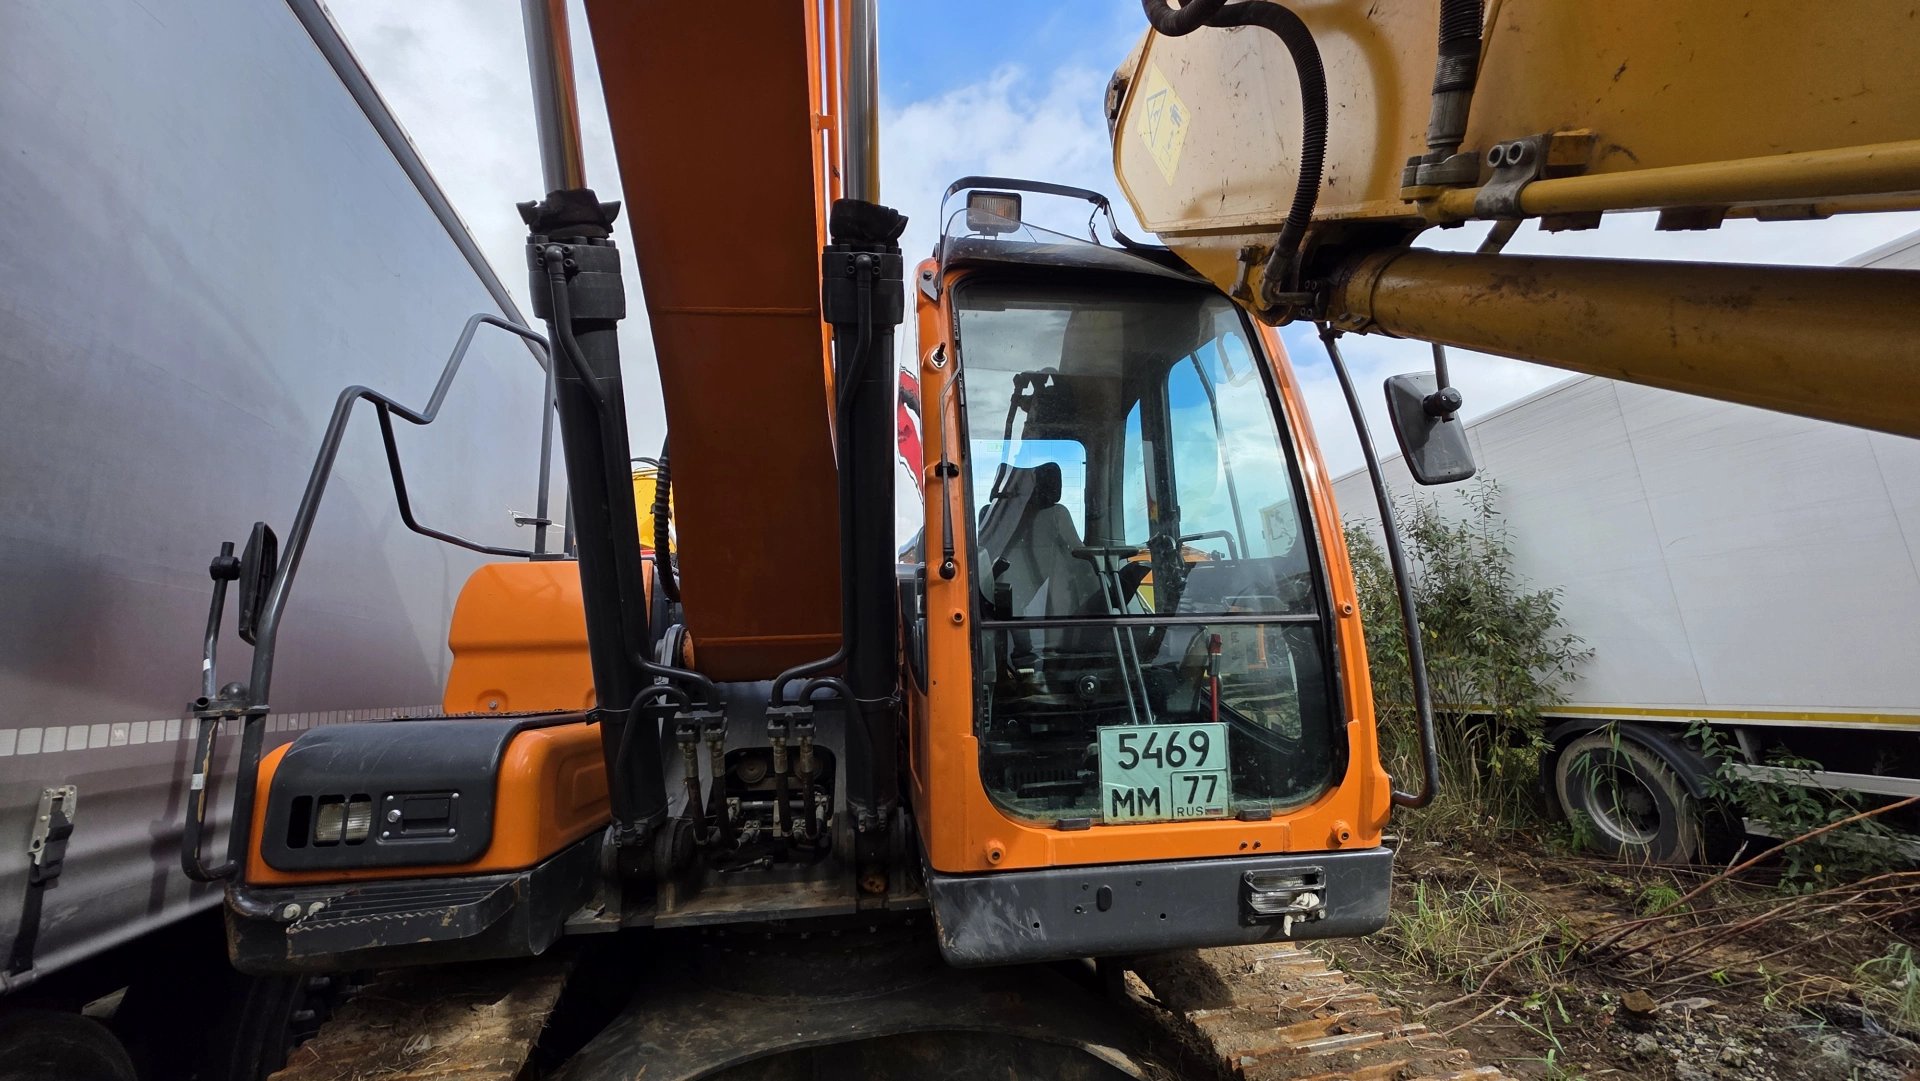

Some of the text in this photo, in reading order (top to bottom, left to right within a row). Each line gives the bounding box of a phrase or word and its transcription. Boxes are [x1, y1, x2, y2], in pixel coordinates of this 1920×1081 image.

[1118, 730, 1210, 770] 5469
[1111, 786, 1161, 818] MM
[1183, 775, 1218, 804] 77
[1177, 806, 1204, 817] RUS
